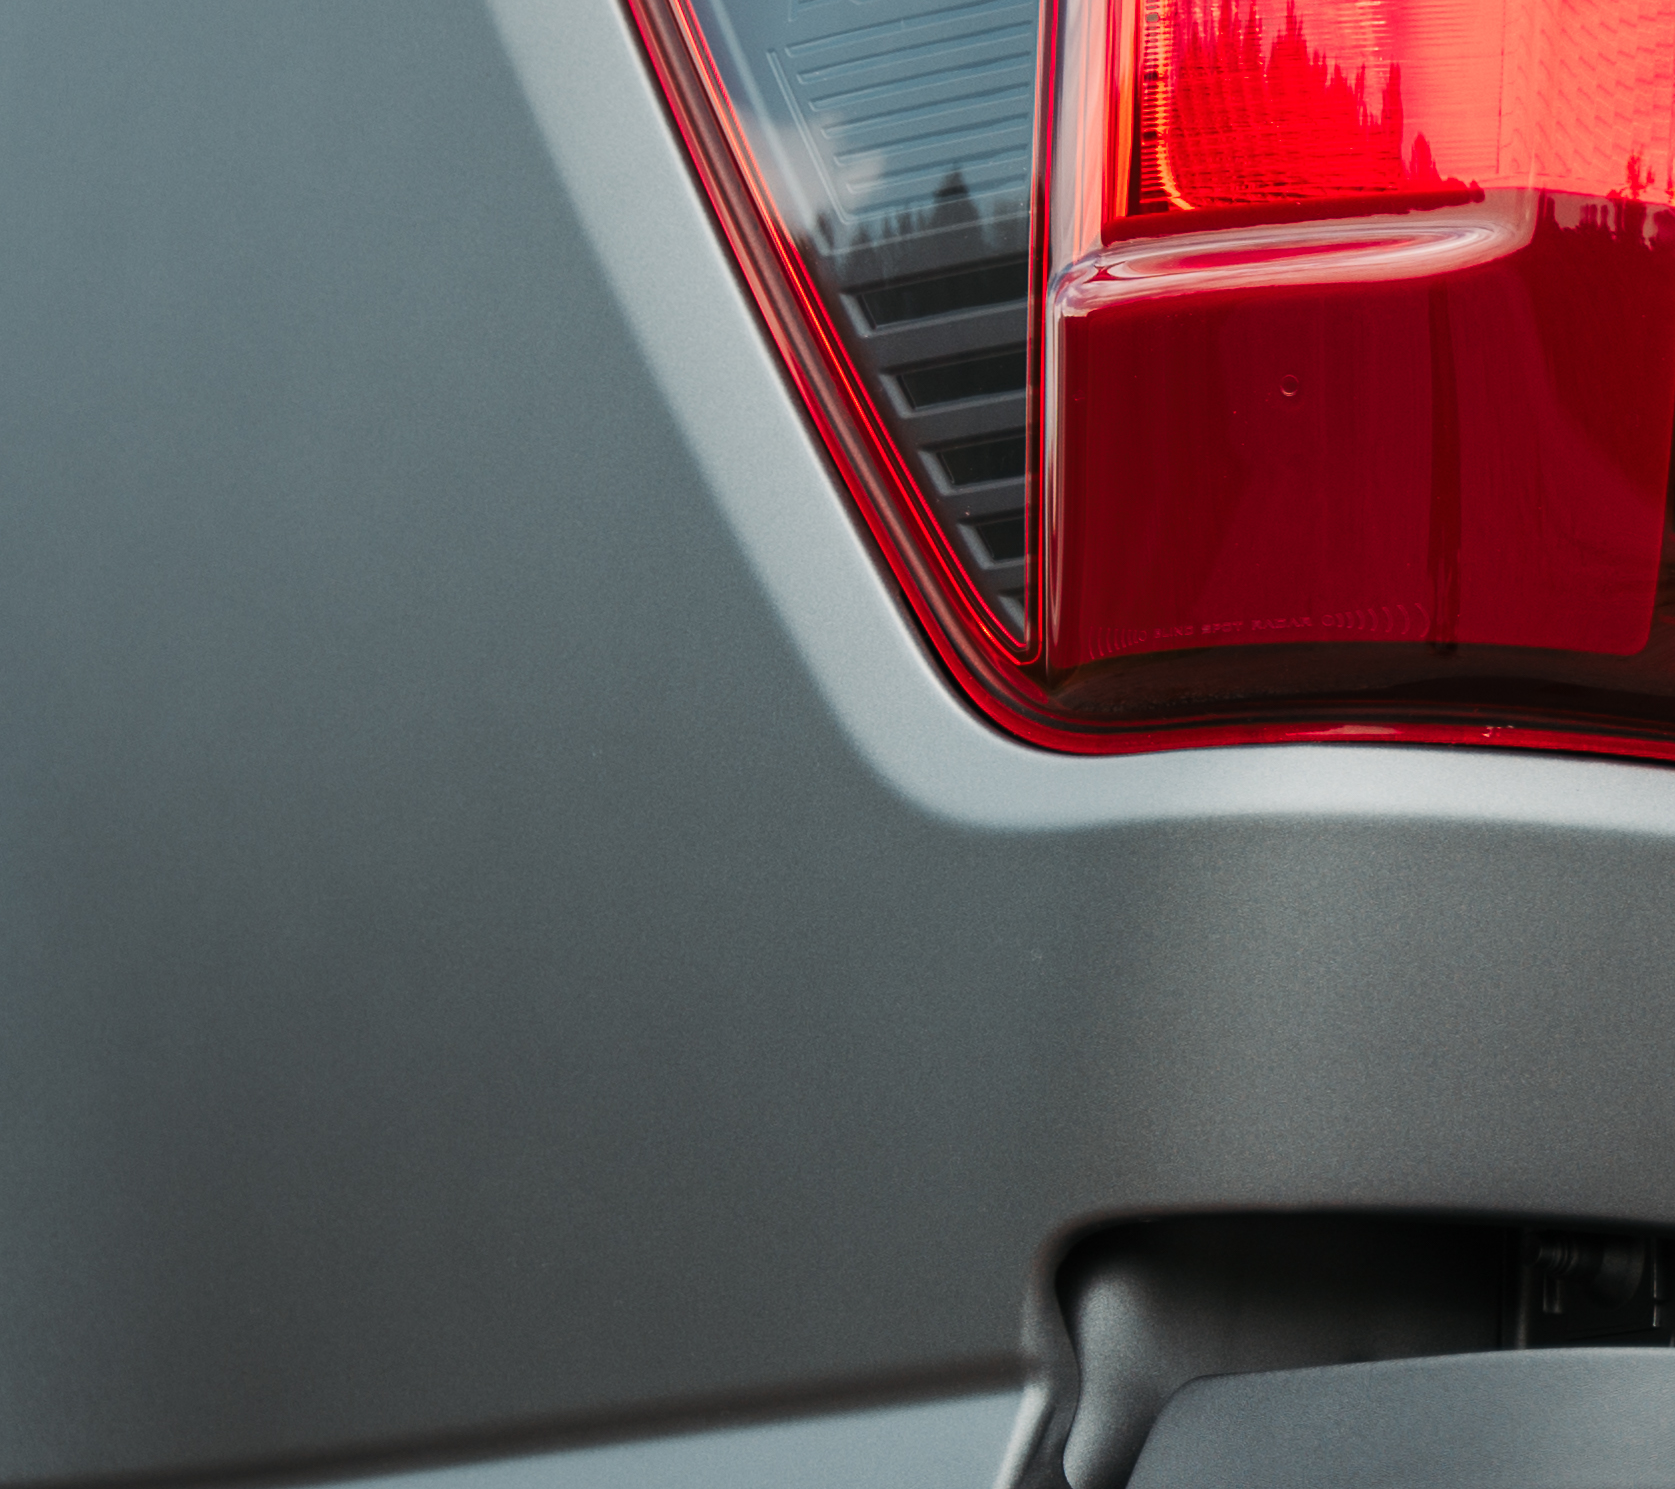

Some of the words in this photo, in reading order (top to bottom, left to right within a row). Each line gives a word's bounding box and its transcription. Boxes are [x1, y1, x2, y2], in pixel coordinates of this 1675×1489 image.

[1153, 625, 1194, 640] BLIND
[1201, 620, 1243, 635] SPOT
[1251, 616, 1312, 631] RADAR
